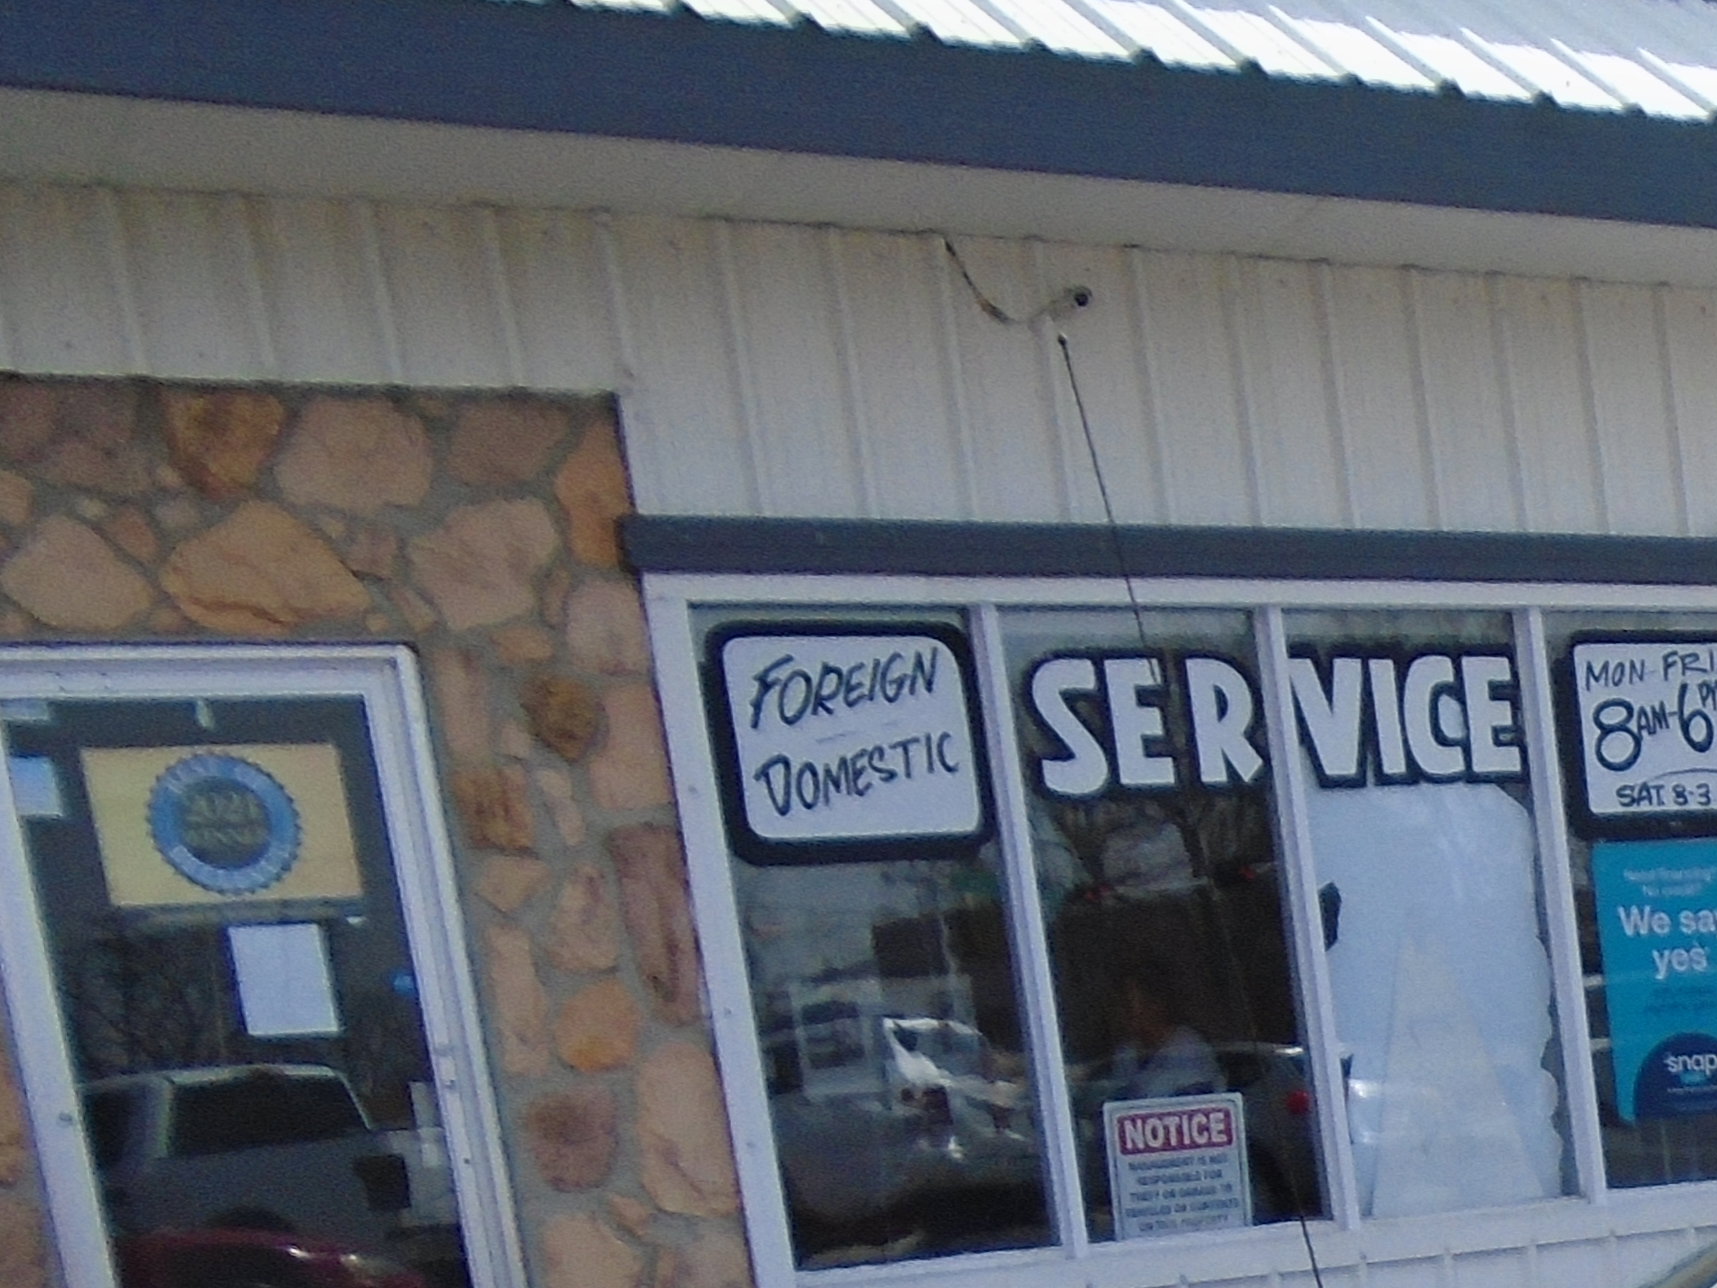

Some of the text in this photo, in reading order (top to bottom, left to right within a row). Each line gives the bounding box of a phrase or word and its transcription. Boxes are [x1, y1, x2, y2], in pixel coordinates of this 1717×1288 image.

[749, 645, 940, 730] FOREIGN
[1030, 655, 1522, 796] SERVICE
[753, 730, 960, 817] DOMESTIC
[1672, 783, 1712, 806] 8-3
[1617, 904, 1672, 937] We
[1652, 947, 1708, 980] yes
[1123, 1111, 1228, 1150] NOTICE
